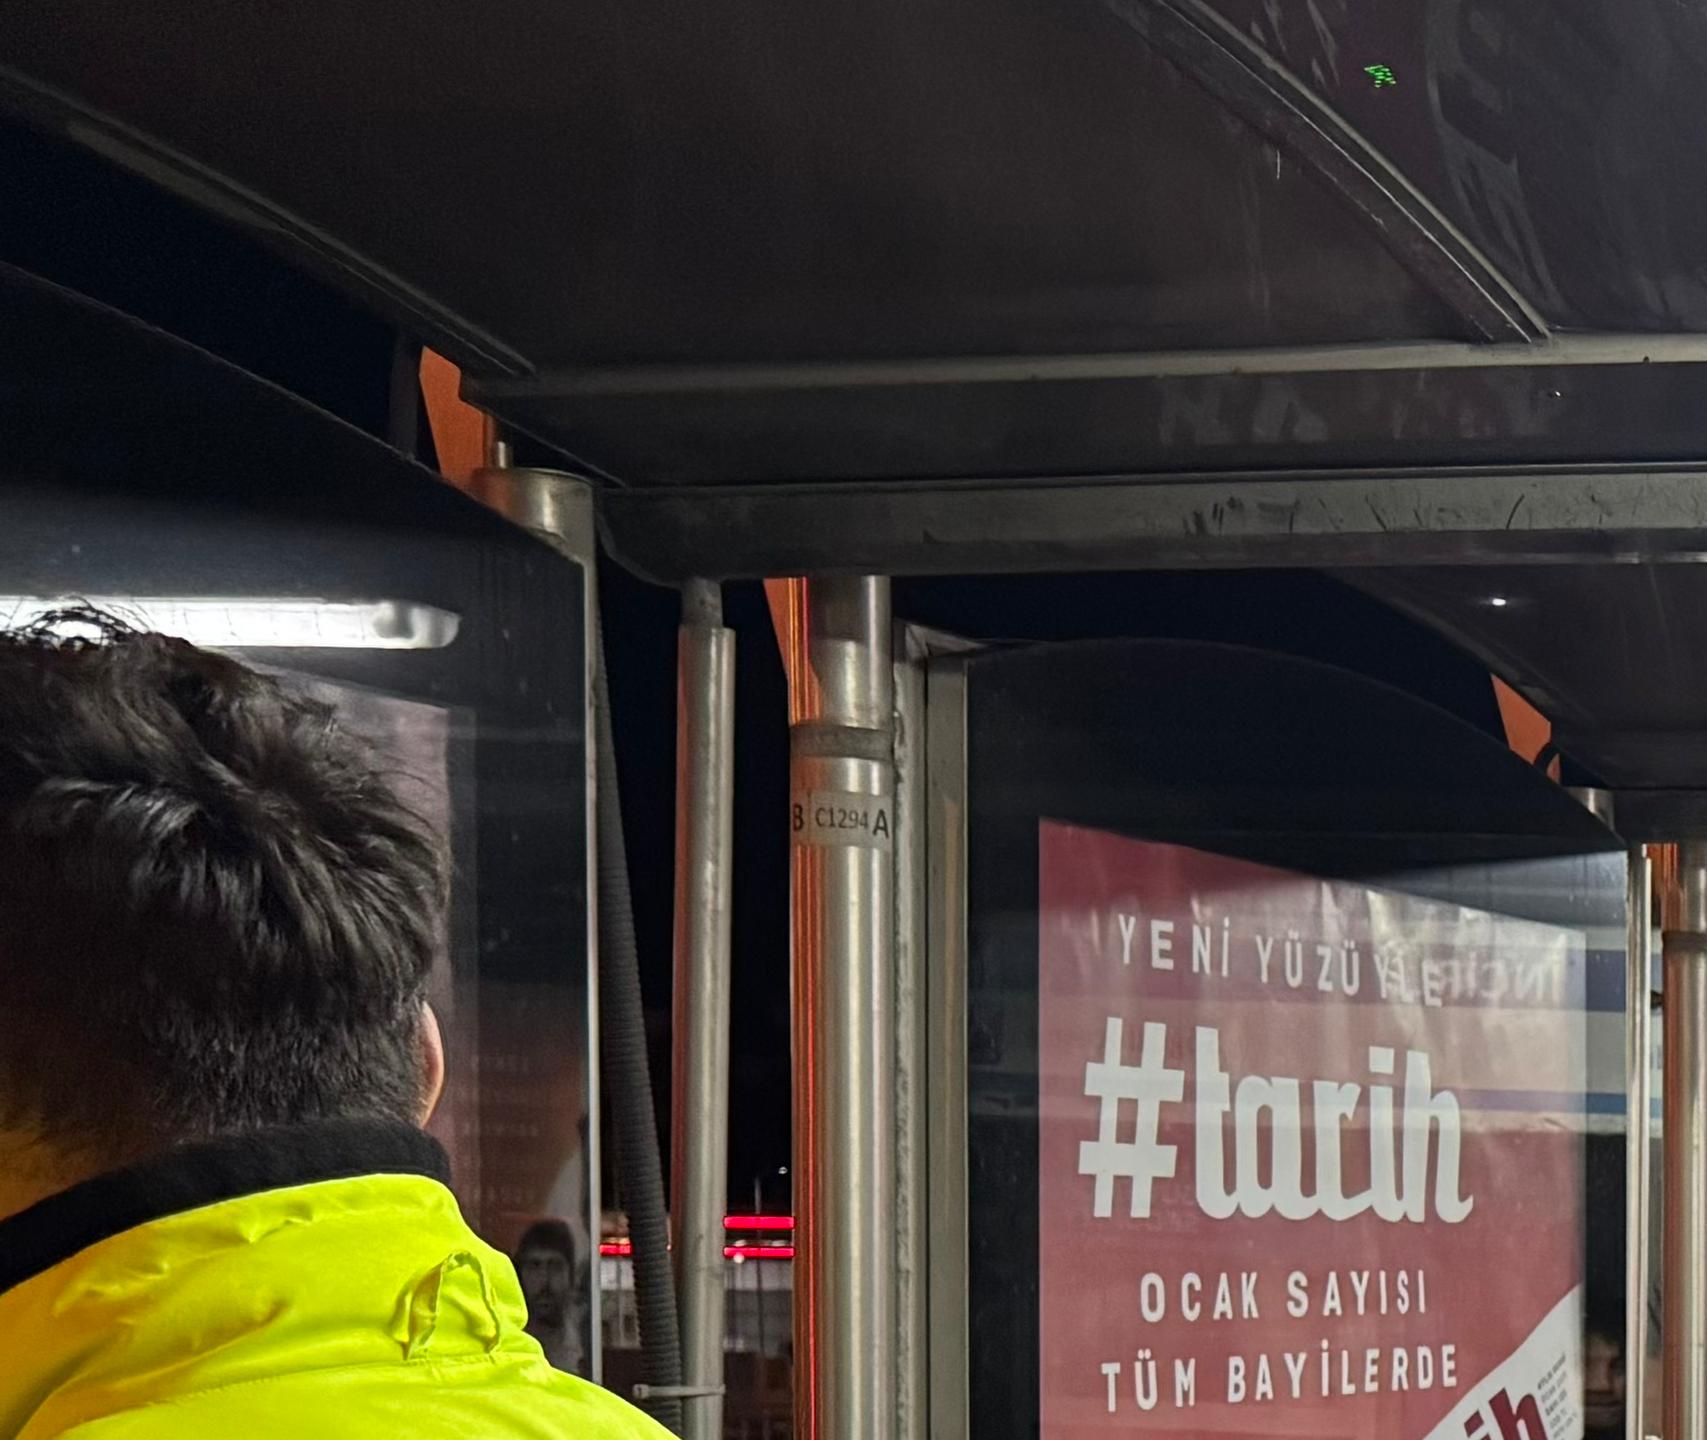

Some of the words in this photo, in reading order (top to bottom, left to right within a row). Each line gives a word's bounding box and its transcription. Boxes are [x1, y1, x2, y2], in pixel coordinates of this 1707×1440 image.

[815, 807, 869, 829] C1294
[872, 808, 889, 839] A
[1118, 913, 1231, 978] YENİ
[1078, 1016, 1474, 1223] #tarih
[1140, 1272, 1260, 1323] OCAK
[1286, 1268, 1427, 1318] SAYISI
[1101, 1349, 1197, 1412] TÜM
[1227, 1339, 1458, 1404] BAYİLERDE
